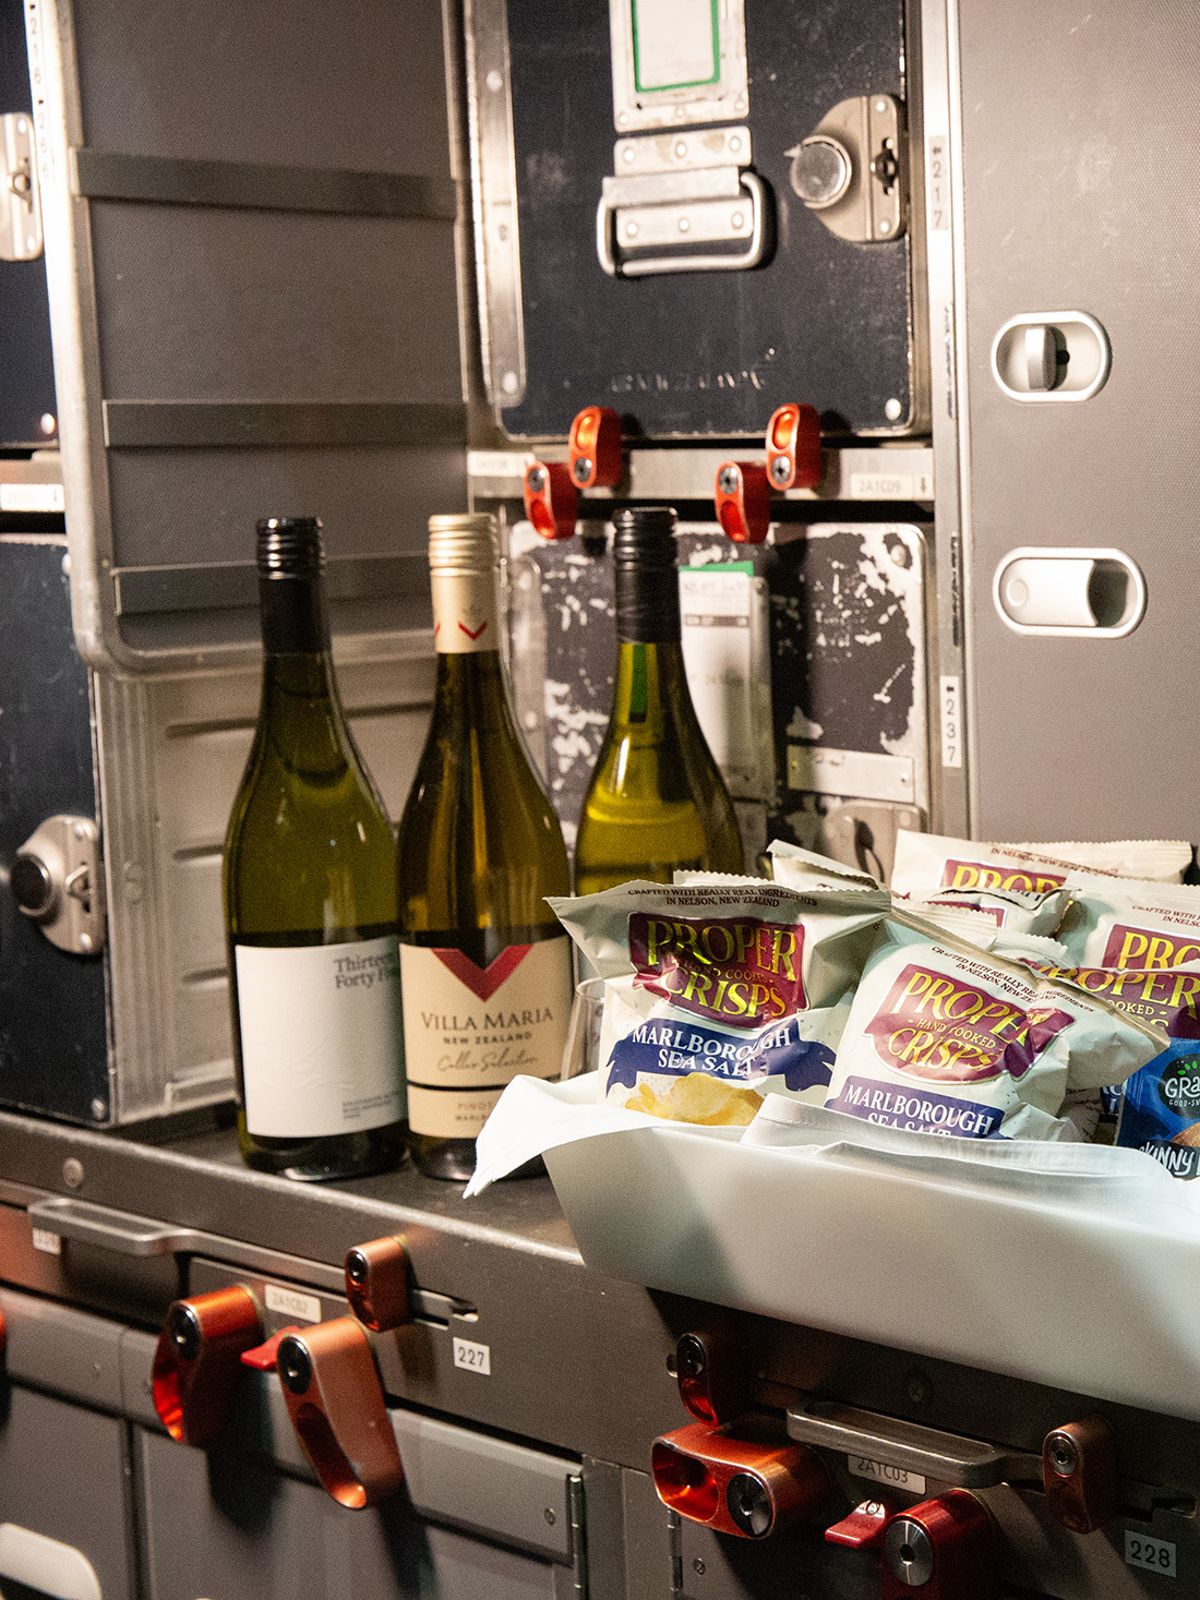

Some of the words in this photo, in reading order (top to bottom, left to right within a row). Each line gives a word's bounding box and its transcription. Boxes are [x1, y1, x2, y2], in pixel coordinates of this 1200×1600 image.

[946, 698, 956, 762] 237
[628, 888, 670, 896] CRAFTED
[670, 888, 696, 896] WITH
[697, 888, 732, 897] REALLY
[732, 889, 758, 897] REAL
[758, 888, 818, 906] INGREDIENTS
[666, 897, 677, 905] IN
[719, 896, 742, 905] NEW
[743, 896, 780, 907] ZEALAND
[1132, 905, 1171, 916] CRAFTED
[1172, 910, 1198, 920] WITH
[1162, 915, 1173, 923] IN
[647, 920, 797, 982] PROPER
[932, 946, 969, 964] CRAFTED
[969, 960, 990, 975] WITH
[990, 969, 1023, 990] REALLY
[956, 963, 967, 973] IN
[968, 967, 1000, 986] NELSON,
[1001, 983, 1021, 997] NEW
[665, 966, 786, 1017] CRISPS
[421, 1012, 478, 1031] VILLA
[484, 1007, 554, 1031] MARIA
[917, 1019, 946, 1033] HAND
[443, 1037, 468, 1045] NEW
[475, 1032, 532, 1045] ZEALAND
[887, 1027, 1000, 1071] CRISPS
[658, 1049, 696, 1070] SEA
[702, 1056, 756, 1077] SALT
[844, 1085, 994, 1135] MARLBOROUGH
[458, 1346, 485, 1367] 227
[1130, 1540, 1169, 1567] 228
